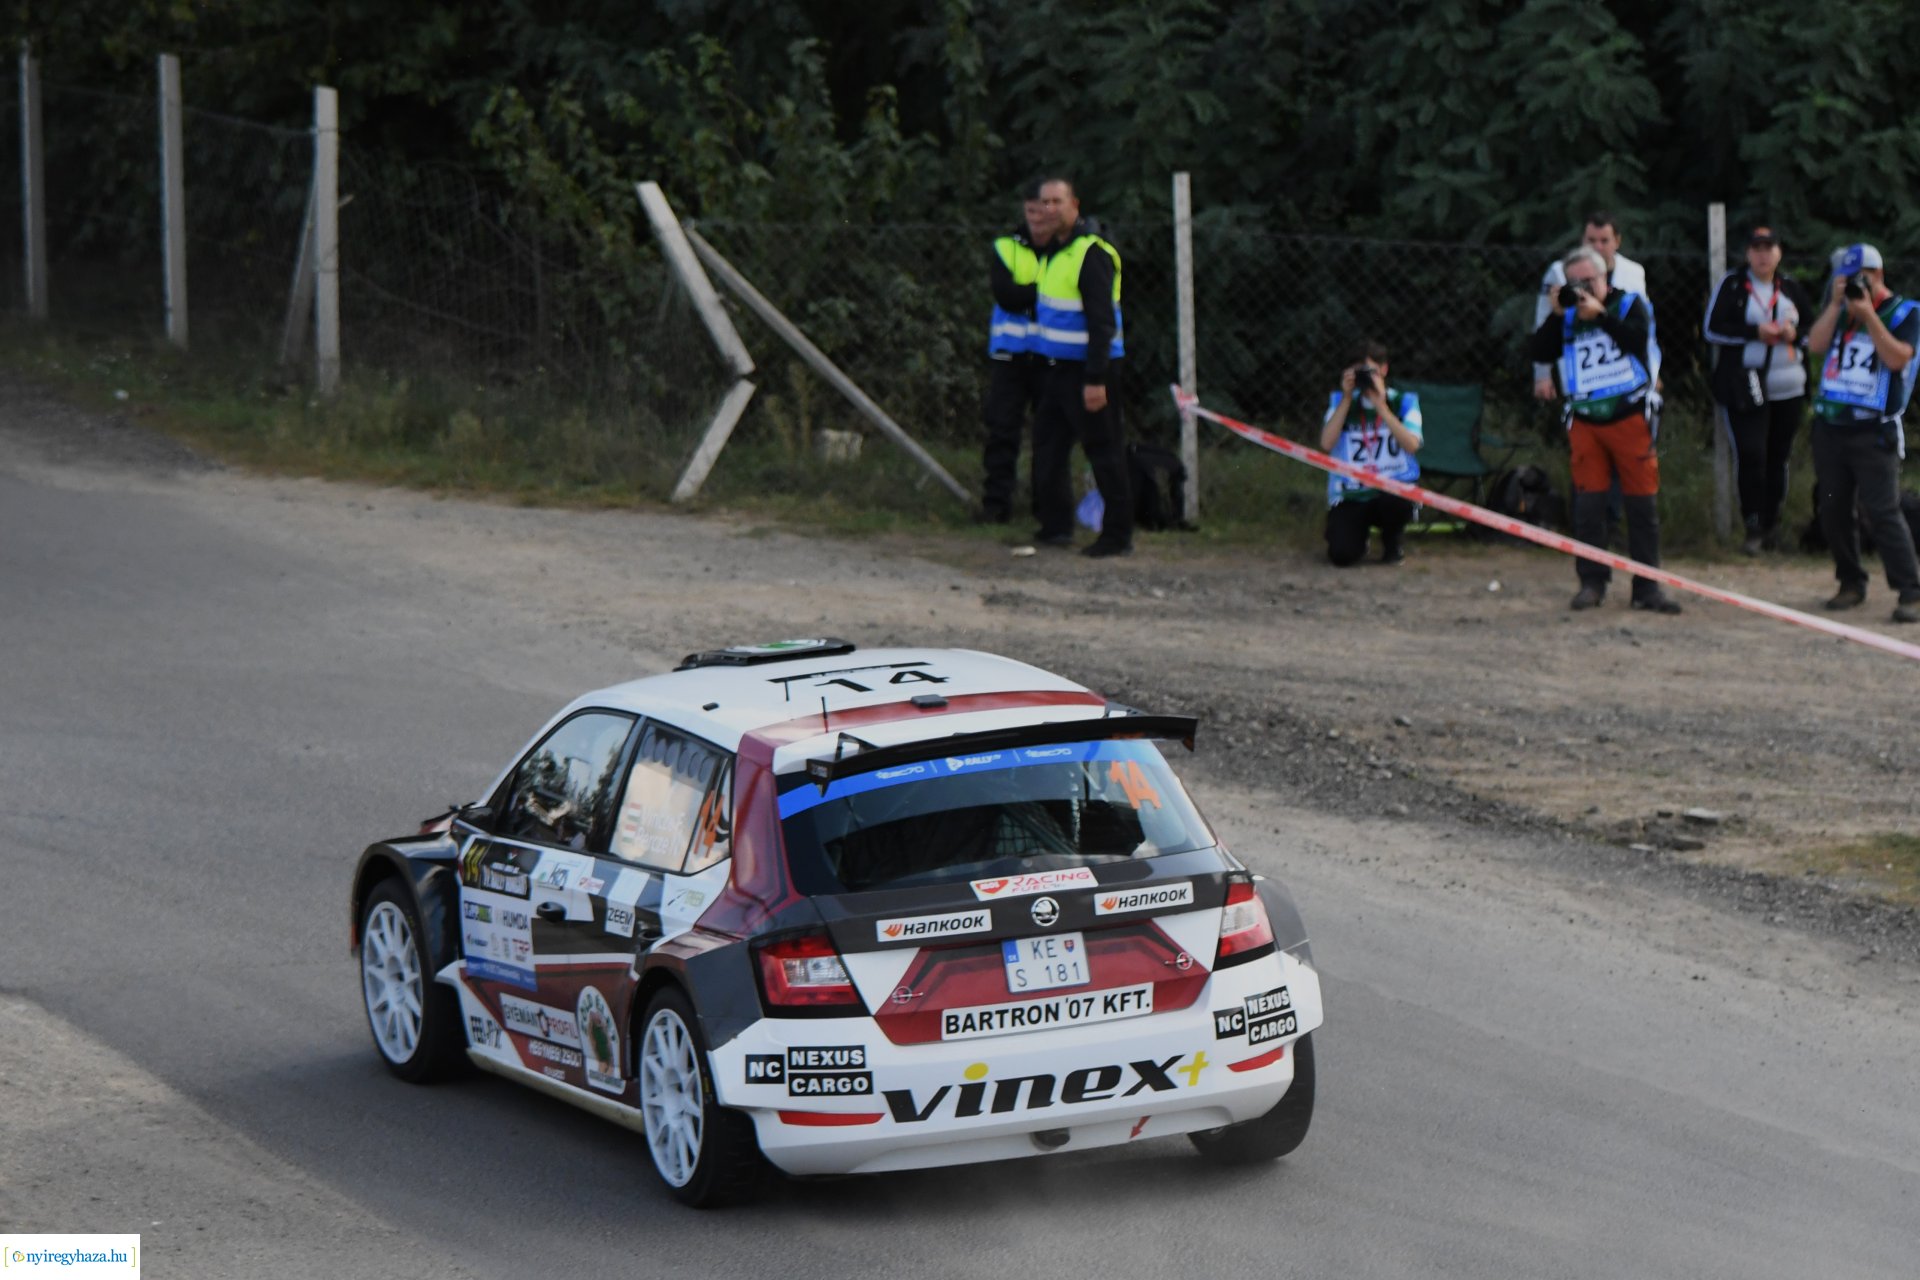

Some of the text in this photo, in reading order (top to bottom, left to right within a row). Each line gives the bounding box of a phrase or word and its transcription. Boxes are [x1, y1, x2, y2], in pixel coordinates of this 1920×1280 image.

[1110, 759, 1162, 810] 14
[1012, 871, 1090, 887] RACING
[1031, 938, 1058, 960] KE
[1015, 961, 1081, 987] S 181
[945, 1005, 1061, 1036] BARTRON
[1102, 988, 1152, 1015] KFT.
[1247, 990, 1291, 1015] NEXUS
[1217, 1014, 1244, 1035] NC
[1249, 1016, 1297, 1043] CARGO
[748, 1059, 783, 1079] NC
[791, 1049, 865, 1068] NEXUS
[791, 1076, 869, 1094] CARGO
